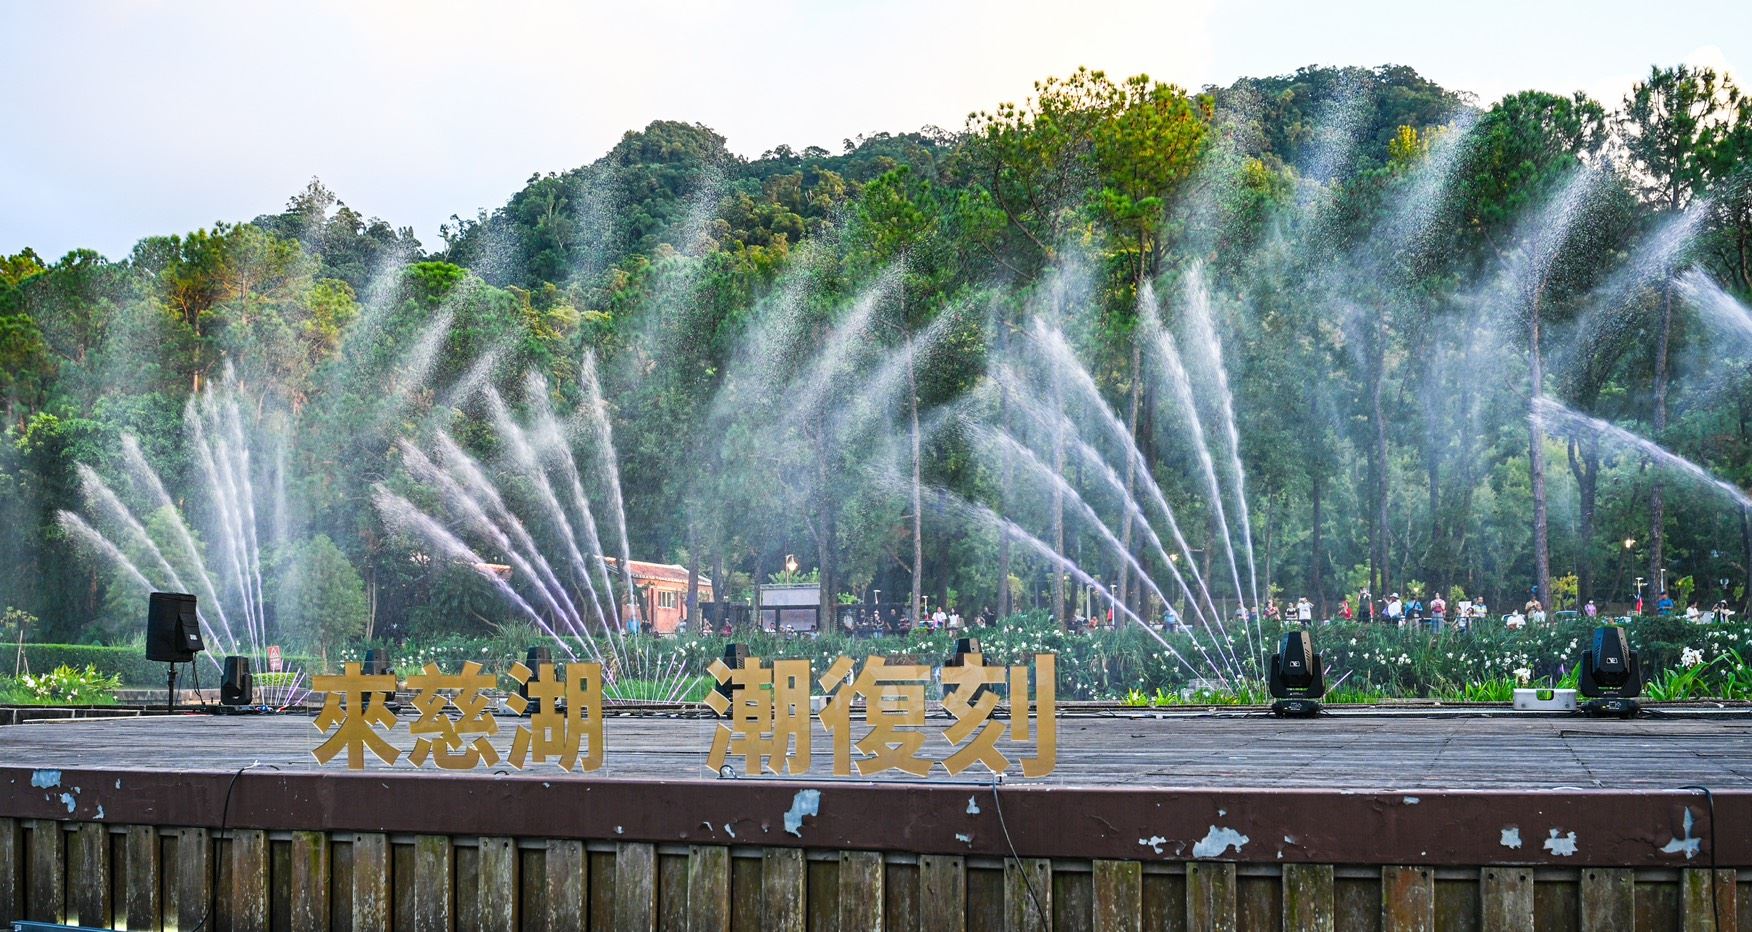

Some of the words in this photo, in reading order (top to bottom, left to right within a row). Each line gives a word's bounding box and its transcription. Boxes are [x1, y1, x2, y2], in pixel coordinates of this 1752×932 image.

[311, 660, 604, 772] 來慈湖
[704, 653, 1056, 778] 潮復刻
